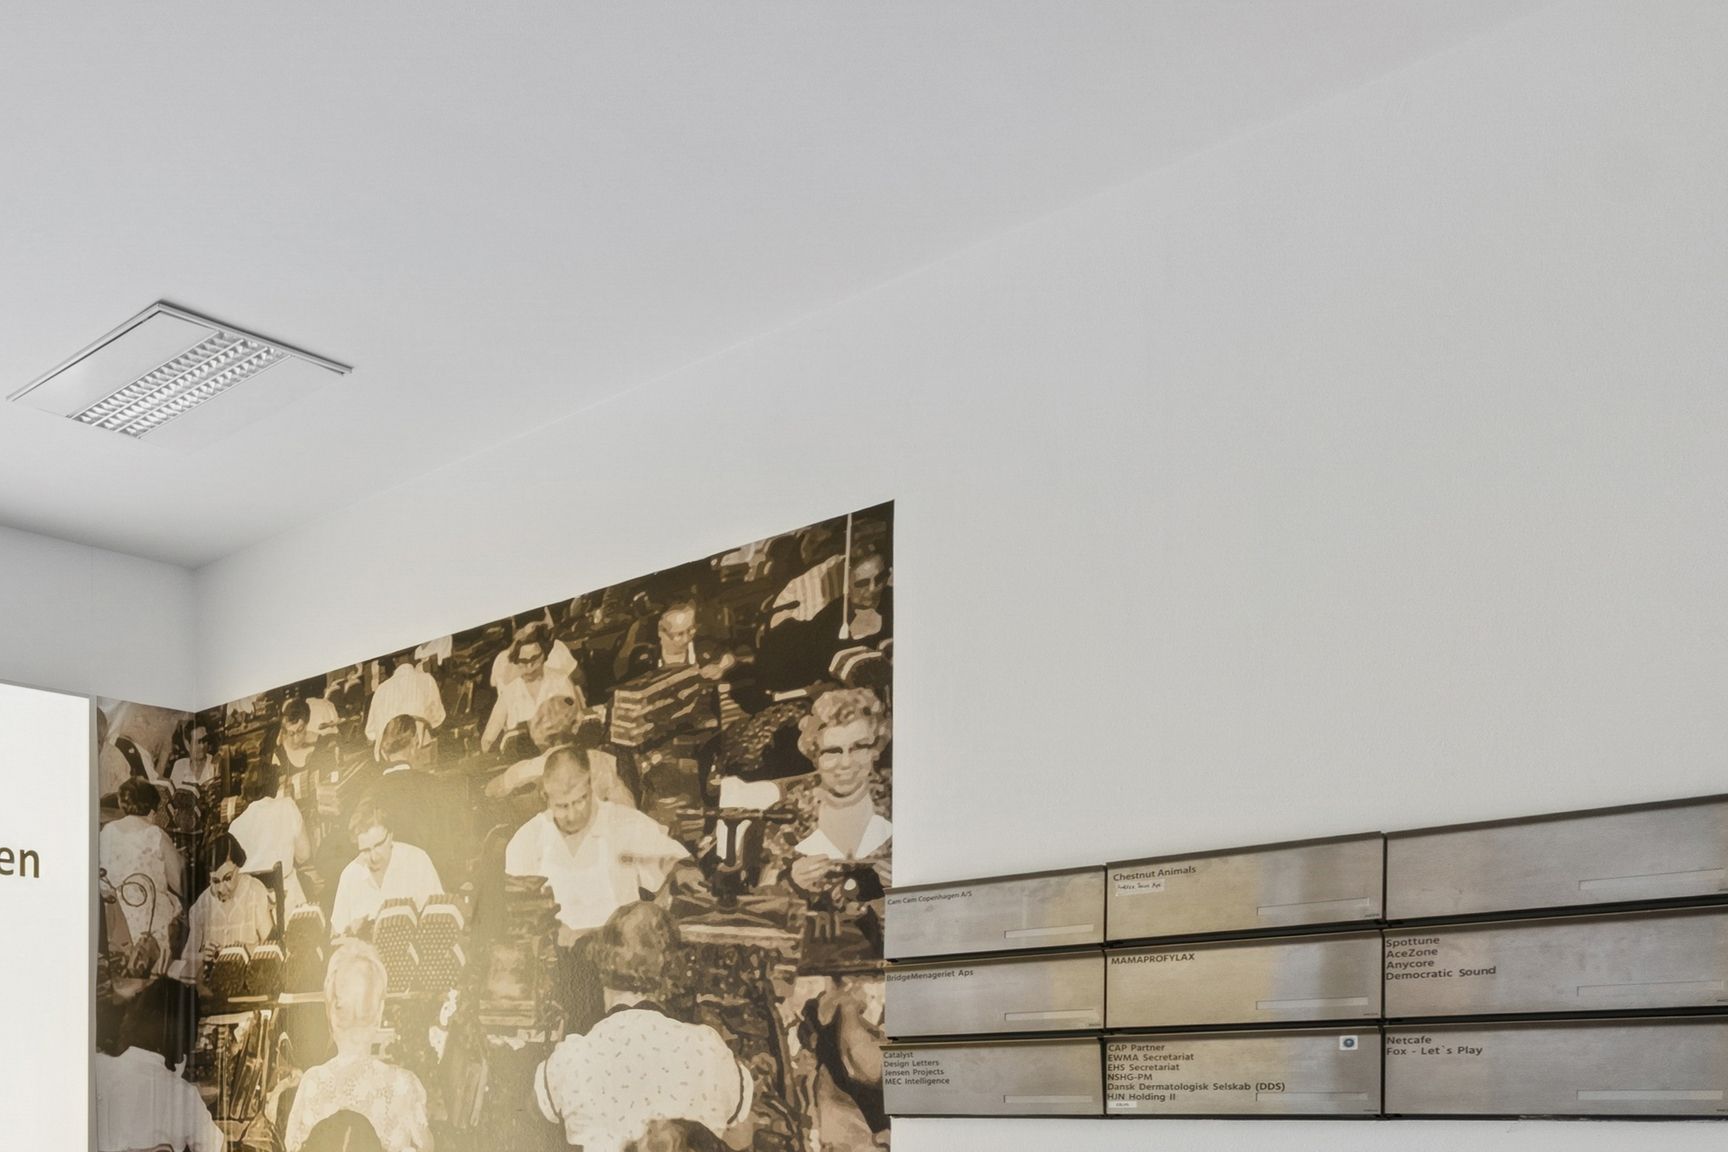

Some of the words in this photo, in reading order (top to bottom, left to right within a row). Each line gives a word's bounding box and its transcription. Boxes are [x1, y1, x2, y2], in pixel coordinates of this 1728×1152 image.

[1113, 871, 1155, 881] Chestnut
[1158, 866, 1196, 877] Animals
[918, 893, 960, 902] Copenhagen
[1386, 937, 1440, 948] Spottune
[1386, 949, 1438, 958] AceZone
[1111, 953, 1195, 965] MAMAPROFYLAX
[1386, 960, 1435, 970] Anycore
[887, 970, 955, 982] BridgeMenageriet
[958, 969, 974, 977] Aps
[1386, 969, 1453, 980] Democratic
[1459, 966, 1497, 977] Sound
[1386, 1036, 1432, 1045] Netcafe
[1108, 1044, 1127, 1052] CAP
[1458, 1046, 1483, 1056] Play
[1108, 1054, 1139, 1062] EWMA
[1143, 1053, 1194, 1061] Secretariat
[884, 1060, 910, 1068] Design
[1129, 1063, 1180, 1071] Secretariat
[913, 1068, 944, 1076] Projects
[905, 1078, 950, 1086] Intelligence
[1139, 1083, 1209, 1092] Dermatologisk
[1213, 1082, 1251, 1091] Selskab
[1255, 1082, 1285, 1092] (DDS)
[1129, 1093, 1166, 1102] Holding
